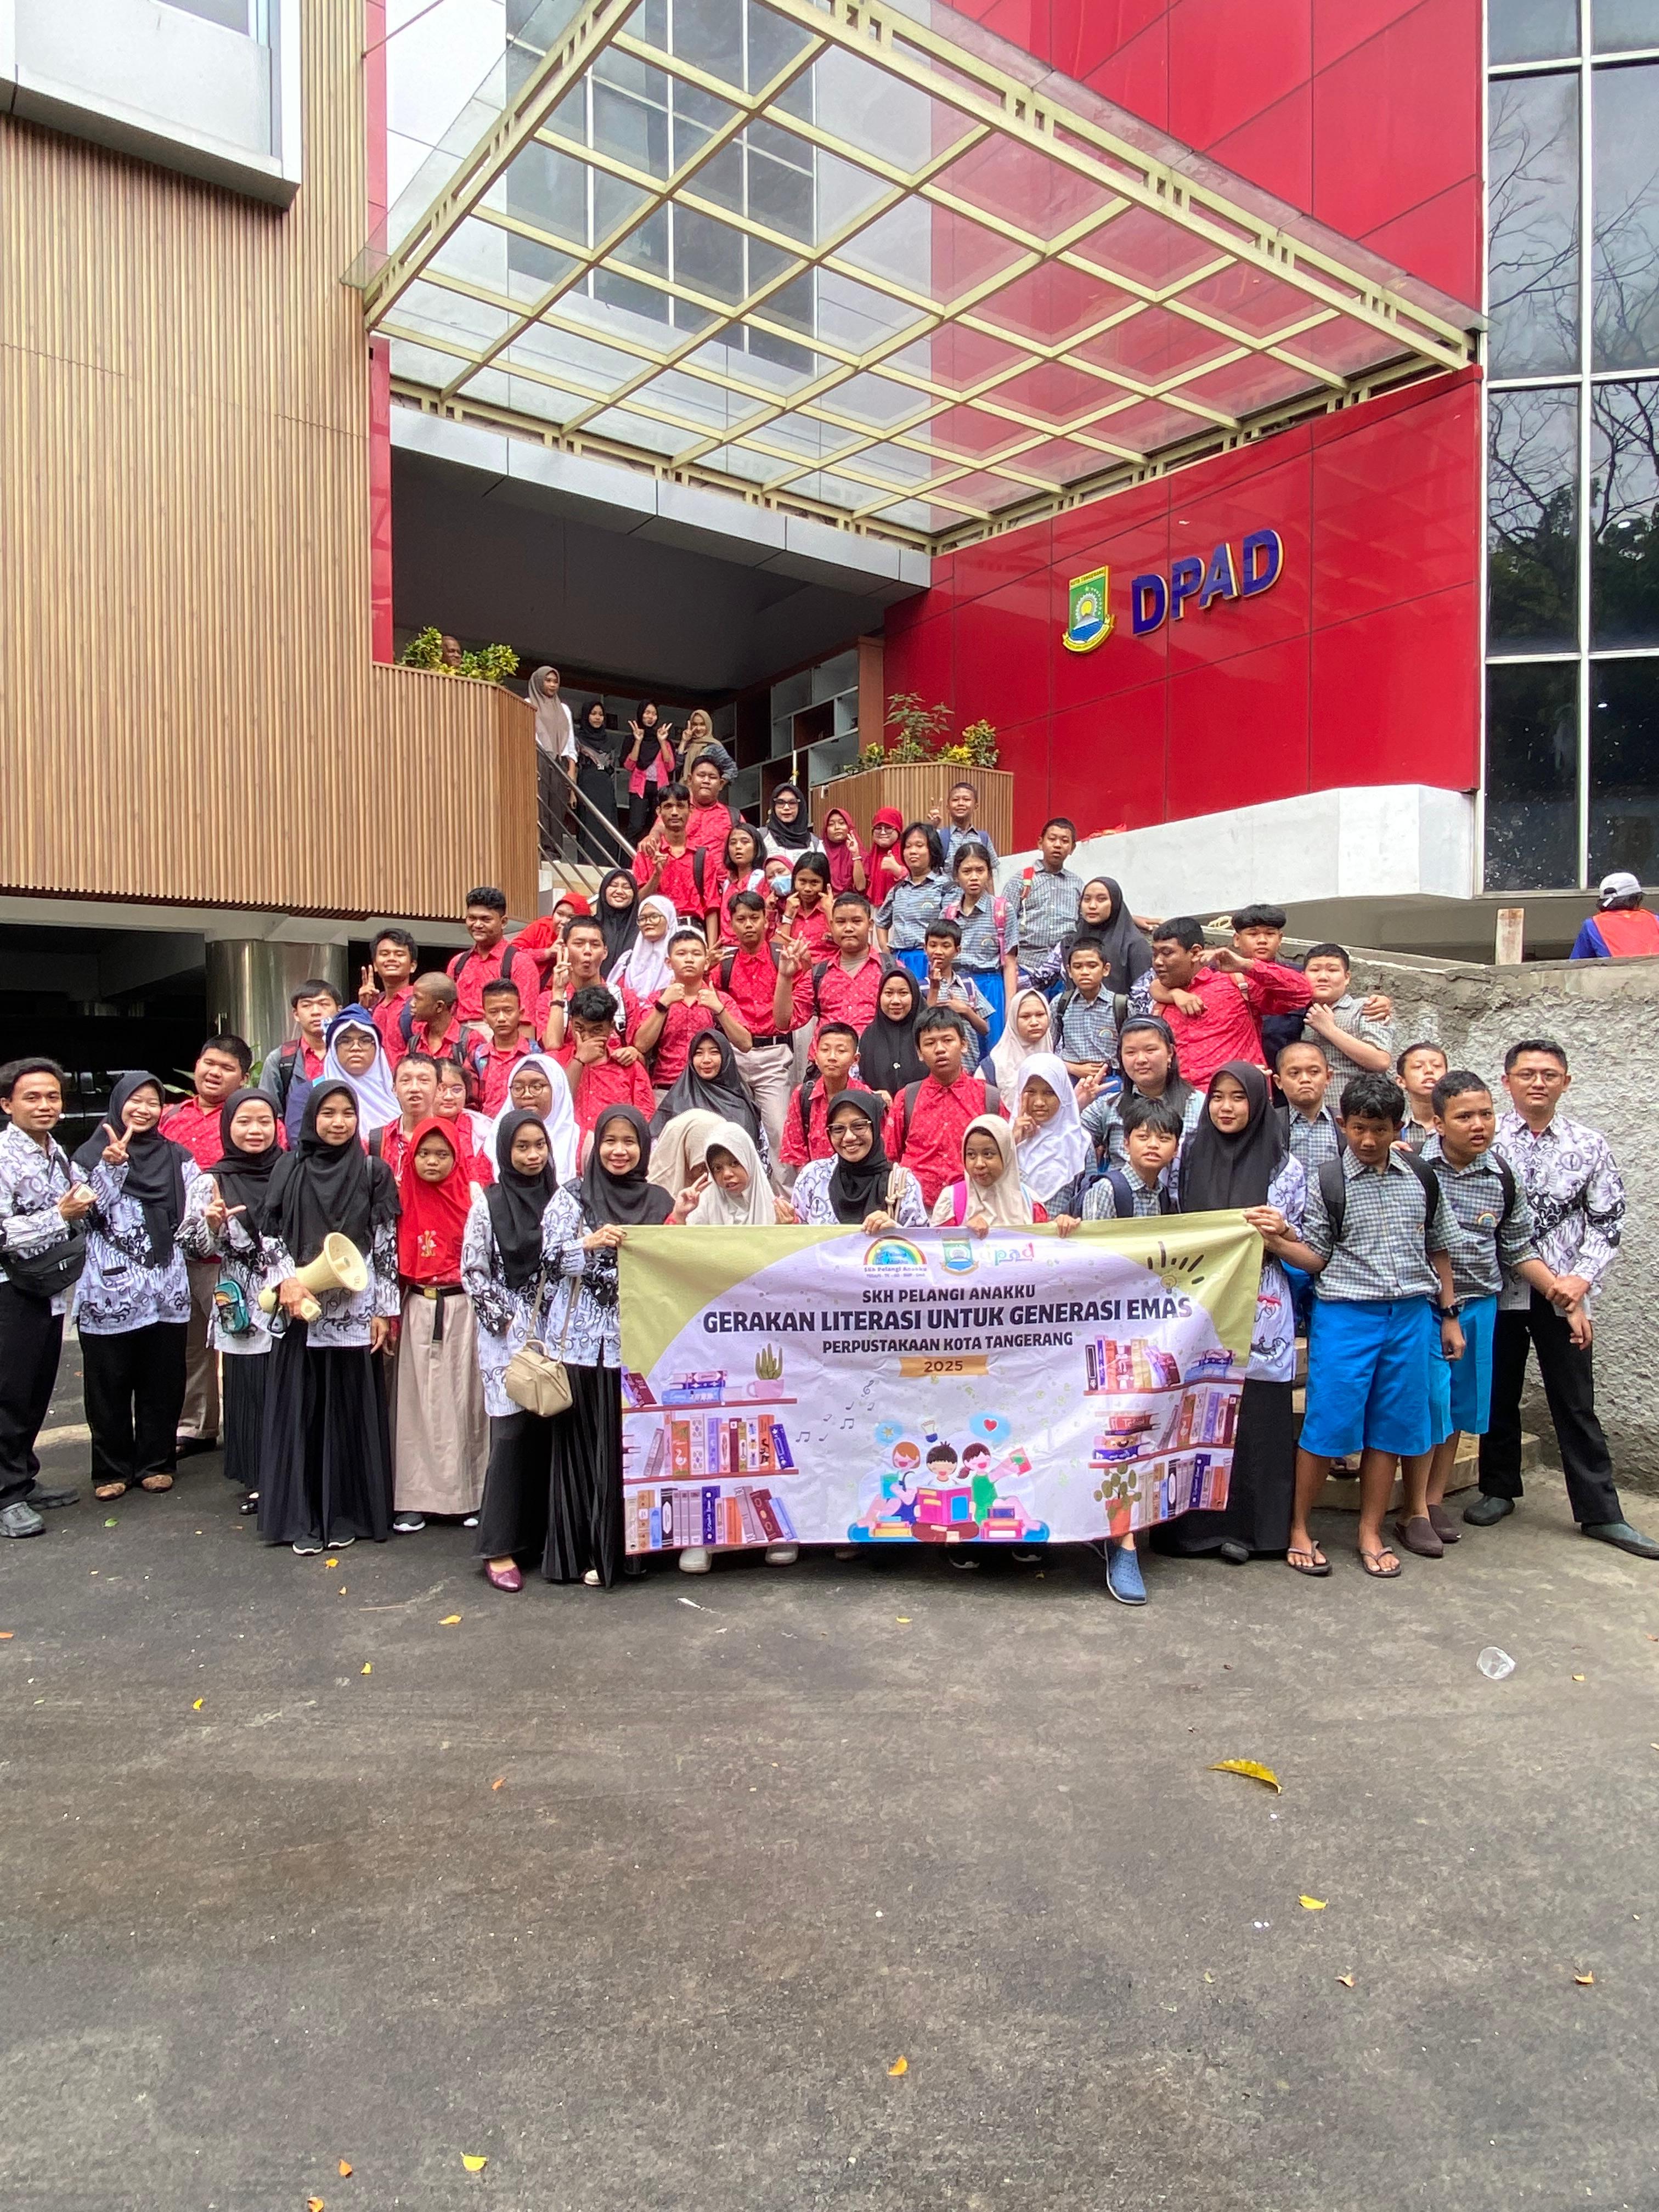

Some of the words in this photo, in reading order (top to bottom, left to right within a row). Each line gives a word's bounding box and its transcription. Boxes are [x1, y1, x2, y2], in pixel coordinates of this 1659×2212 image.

[1132, 529, 1283, 635] DPAD
[862, 1289, 894, 1303] SKH
[899, 1288, 964, 1302] PELANGI
[969, 1284, 1035, 1300] ANAKKU
[703, 1312, 815, 1333] GERAKAN
[821, 1310, 922, 1331] LITERASI
[928, 1306, 1004, 1329] UNTUK
[1009, 1300, 1121, 1325] GENERASI
[1126, 1297, 1193, 1319] EMAS
[823, 1338, 940, 1353] PERPUSTAKAAN
[944, 1336, 982, 1351] KOTA
[985, 1332, 1073, 1348] TANGERANG
[924, 1361, 963, 1373] 2025
